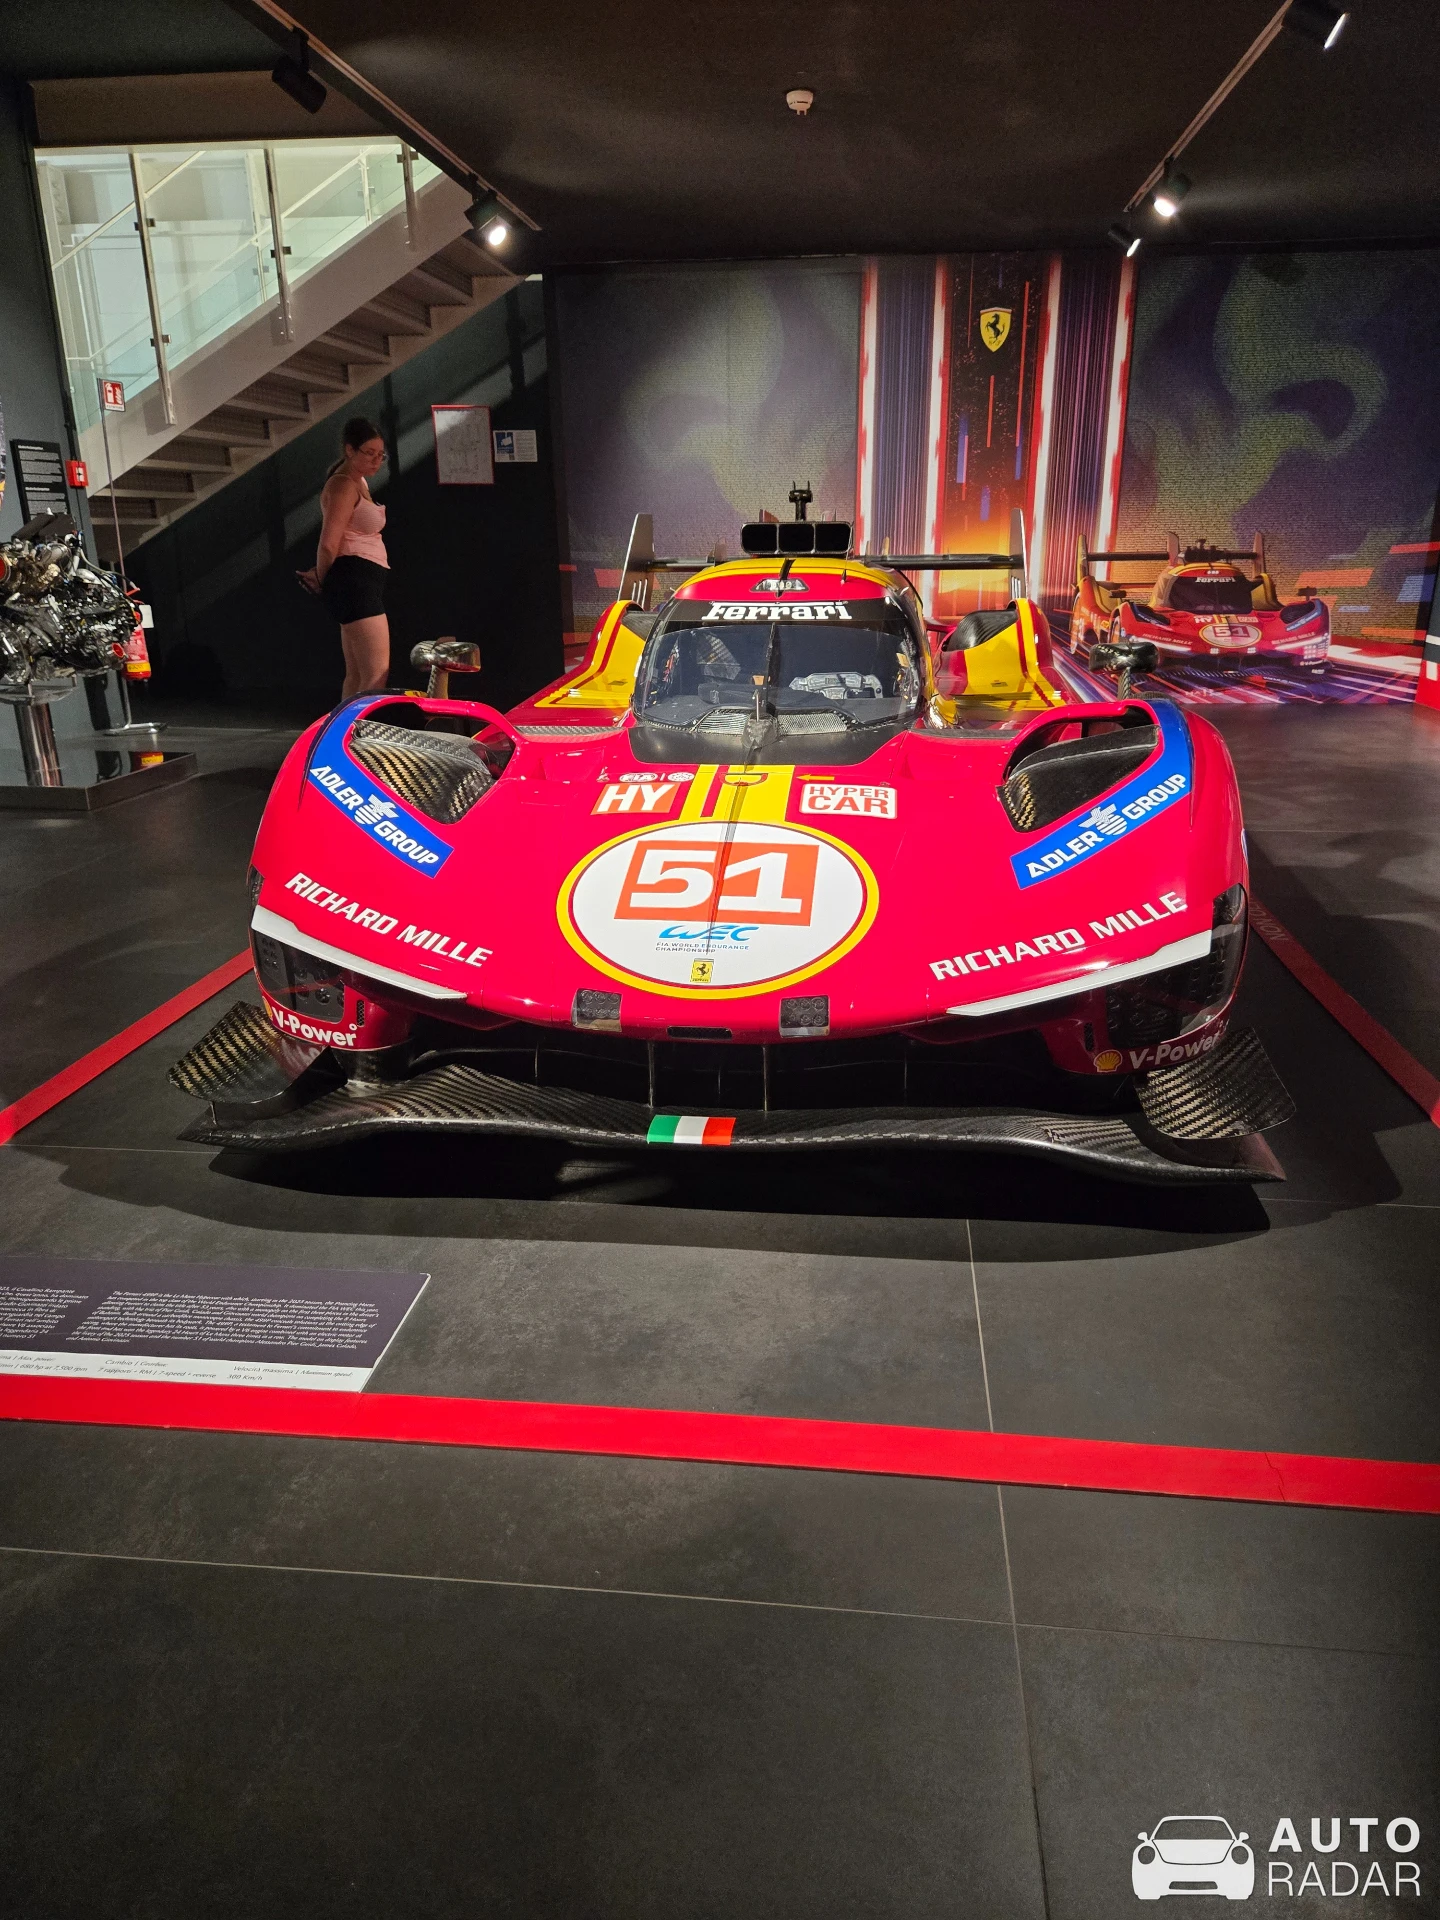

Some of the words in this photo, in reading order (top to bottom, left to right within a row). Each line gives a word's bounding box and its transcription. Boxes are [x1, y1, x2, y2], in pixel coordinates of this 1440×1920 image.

[701, 601, 853, 621] Ferrari
[1214, 625, 1250, 638] 51
[596, 784, 676, 812] HY
[806, 795, 889, 814] CAR
[808, 785, 889, 800] HYPER
[310, 765, 364, 811] ADLER
[373, 820, 440, 866] GROUP
[1026, 829, 1105, 879] ADLER
[1121, 773, 1187, 821] GROUP
[629, 849, 803, 914] 51
[284, 872, 398, 935] RICHARD
[396, 924, 493, 967] MILLE
[929, 927, 1086, 981] RICHARD
[1088, 891, 1188, 940] MILLE
[701, 943, 750, 951] ENDURANCE
[272, 1006, 357, 1047] V-Power
[1129, 1031, 1222, 1069] V-Power
